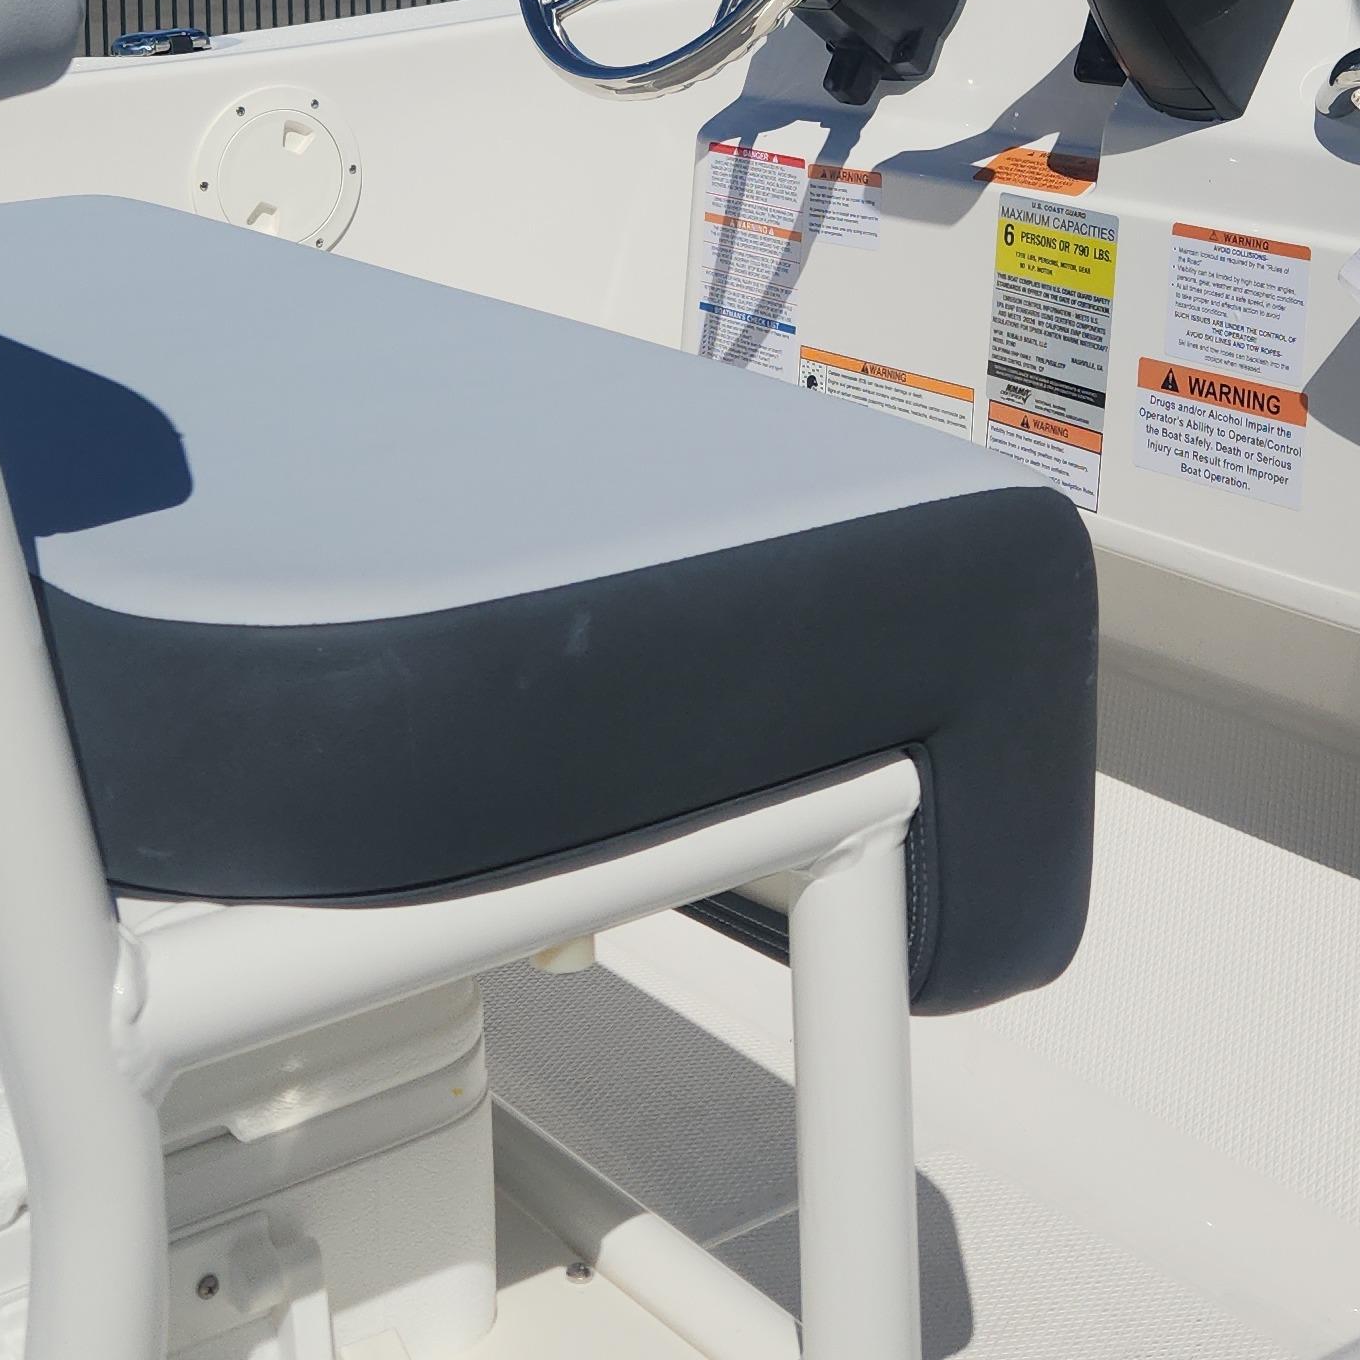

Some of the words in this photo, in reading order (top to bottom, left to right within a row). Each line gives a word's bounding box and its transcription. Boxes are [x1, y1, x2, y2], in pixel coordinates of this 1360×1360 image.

[829, 170, 868, 184] WARNING
[1045, 205, 1064, 214] COAST
[1001, 206, 1050, 229] MAXIMUM
[1052, 218, 1115, 241] CAPACITIES
[1004, 224, 1014, 246] 6
[1021, 232, 1056, 249] PERSONS
[1059, 240, 1070, 253] OR
[1074, 244, 1089, 257] 790
[1094, 248, 1112, 262] LBS.
[1214, 245, 1230, 254] AVOID
[1223, 233, 1269, 250] WARNING
[1191, 315, 1210, 324] ISSUES
[1225, 321, 1244, 332] UNDER
[1259, 330, 1287, 342] CONTROL
[1215, 337, 1231, 346] LINES
[1233, 341, 1245, 349] AND
[1247, 344, 1259, 353] TOW
[869, 364, 907, 383] WARNING
[1188, 376, 1281, 415] WARNING
[1033, 419, 1069, 438] WARNING
[1150, 395, 1175, 410] Drugs
[1178, 402, 1206, 417] and/or
[1208, 409, 1242, 426] Alcohol
[1245, 418, 1274, 434] Impair
[1277, 427, 1291, 439] the
[1139, 407, 1183, 427] Operator's
[1186, 419, 1213, 436] Ability
[1217, 427, 1225, 437] to
[1228, 430, 1302, 457] Operate/Control
[1146, 424, 1159, 436] the
[1162, 428, 1182, 442] Boat
[1216, 441, 1241, 456] Death
[1245, 450, 1254, 459] or
[1257, 452, 1292, 471] Serious
[1147, 439, 1172, 456] Injury
[1174, 449, 1189, 458] can
[1192, 450, 1221, 467] Result
[1223, 459, 1244, 473] from
[1247, 465, 1288, 486] Improper
[1181, 463, 1201, 477] Boat
[1204, 468, 1250, 491] Operation.
